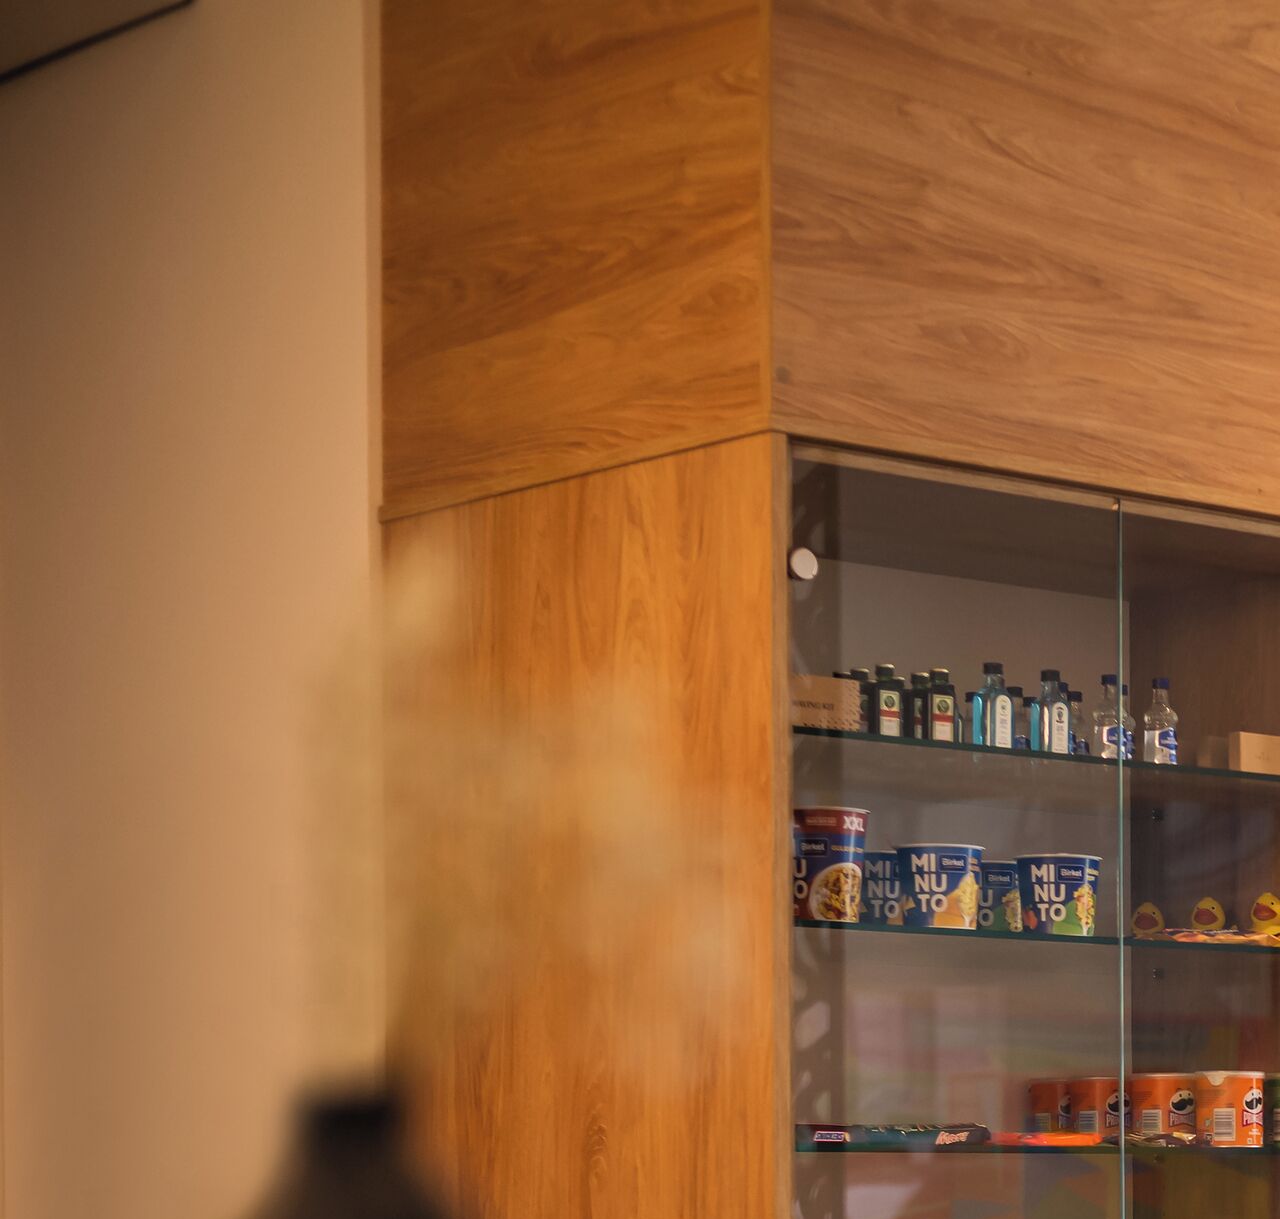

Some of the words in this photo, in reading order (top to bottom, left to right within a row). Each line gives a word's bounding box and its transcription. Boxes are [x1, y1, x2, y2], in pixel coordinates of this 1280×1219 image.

[843, 815, 865, 832] XXL
[865, 860, 891, 879] MI
[910, 853, 936, 872] MI
[942, 856, 964, 867] Birkel
[1031, 864, 1055, 882] MI
[1060, 868, 1082, 878] Birkel
[868, 880, 900, 898] NU
[914, 873, 947, 892] NU
[1034, 884, 1066, 902] NU
[871, 900, 900, 919] TO
[917, 894, 948, 913] TO
[1037, 903, 1067, 922] TO
